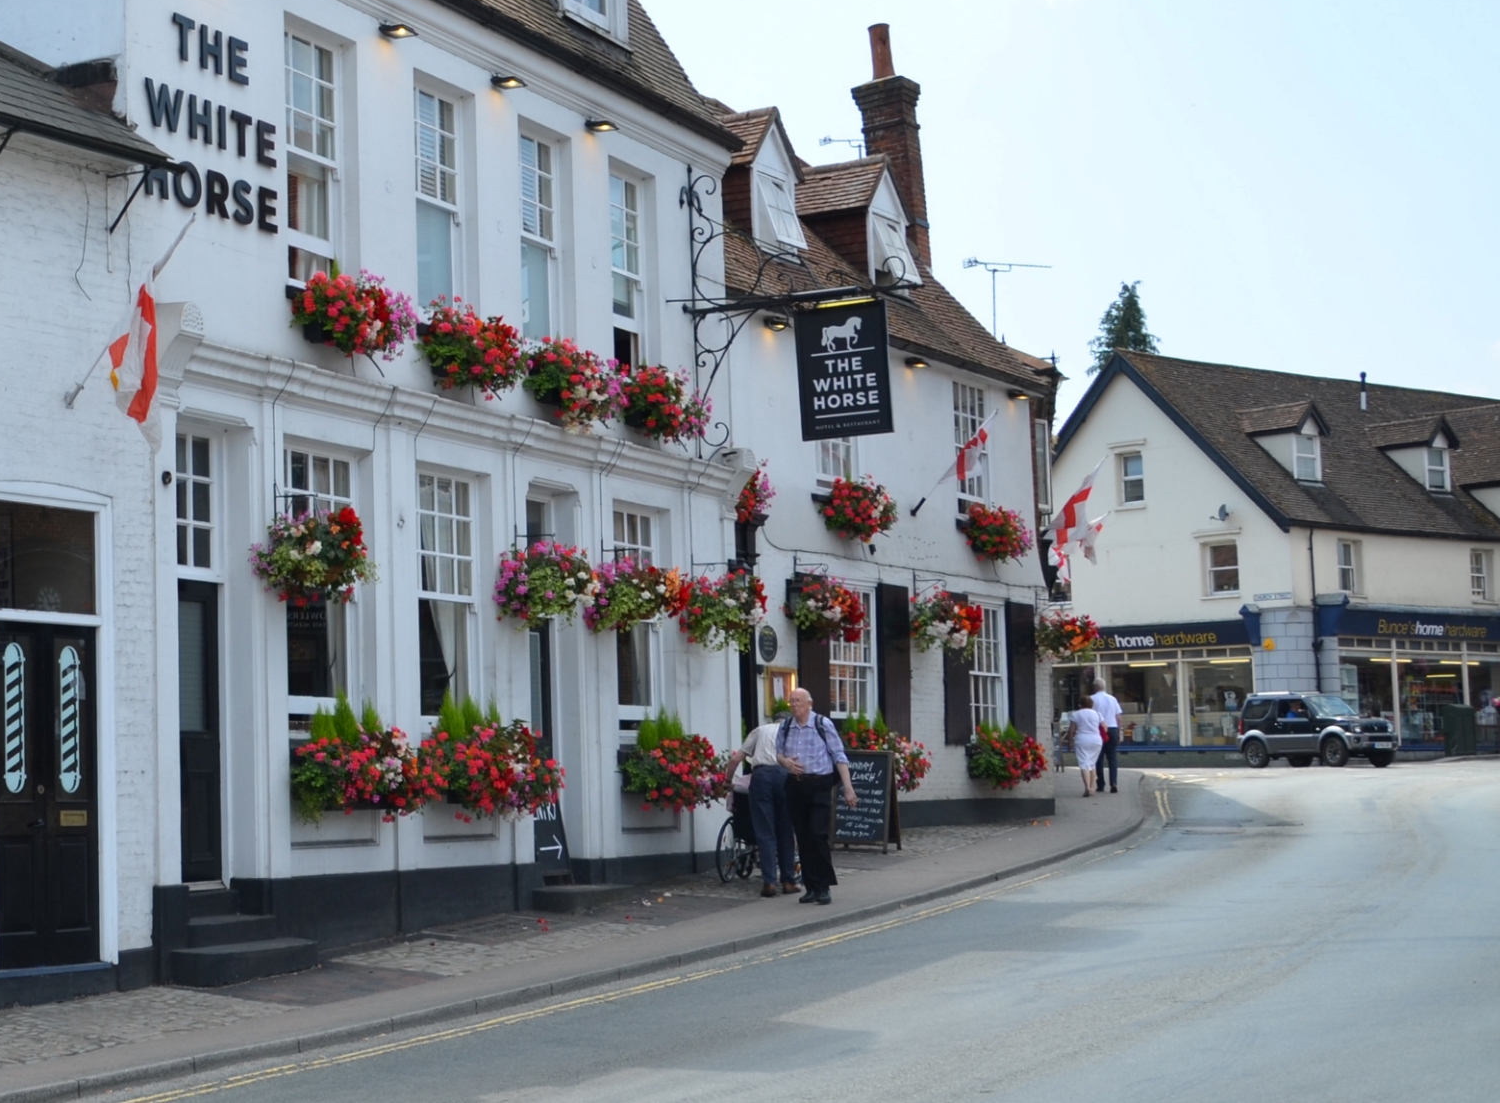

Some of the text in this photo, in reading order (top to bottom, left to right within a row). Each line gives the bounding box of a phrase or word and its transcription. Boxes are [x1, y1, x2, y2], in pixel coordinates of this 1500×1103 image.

[173, 12, 249, 86] THE
[145, 77, 277, 168] WHITE
[824, 356, 863, 374] THE
[812, 372, 877, 393] WHITE
[813, 390, 880, 411] HORSE
[843, 419, 881, 428] RESTAURANT
[1377, 619, 1488, 637] Bunce's home hardware
[1114, 634, 1155, 648] home
[1154, 631, 1218, 646] hardware
[847, 761, 875, 772] UNDAY
